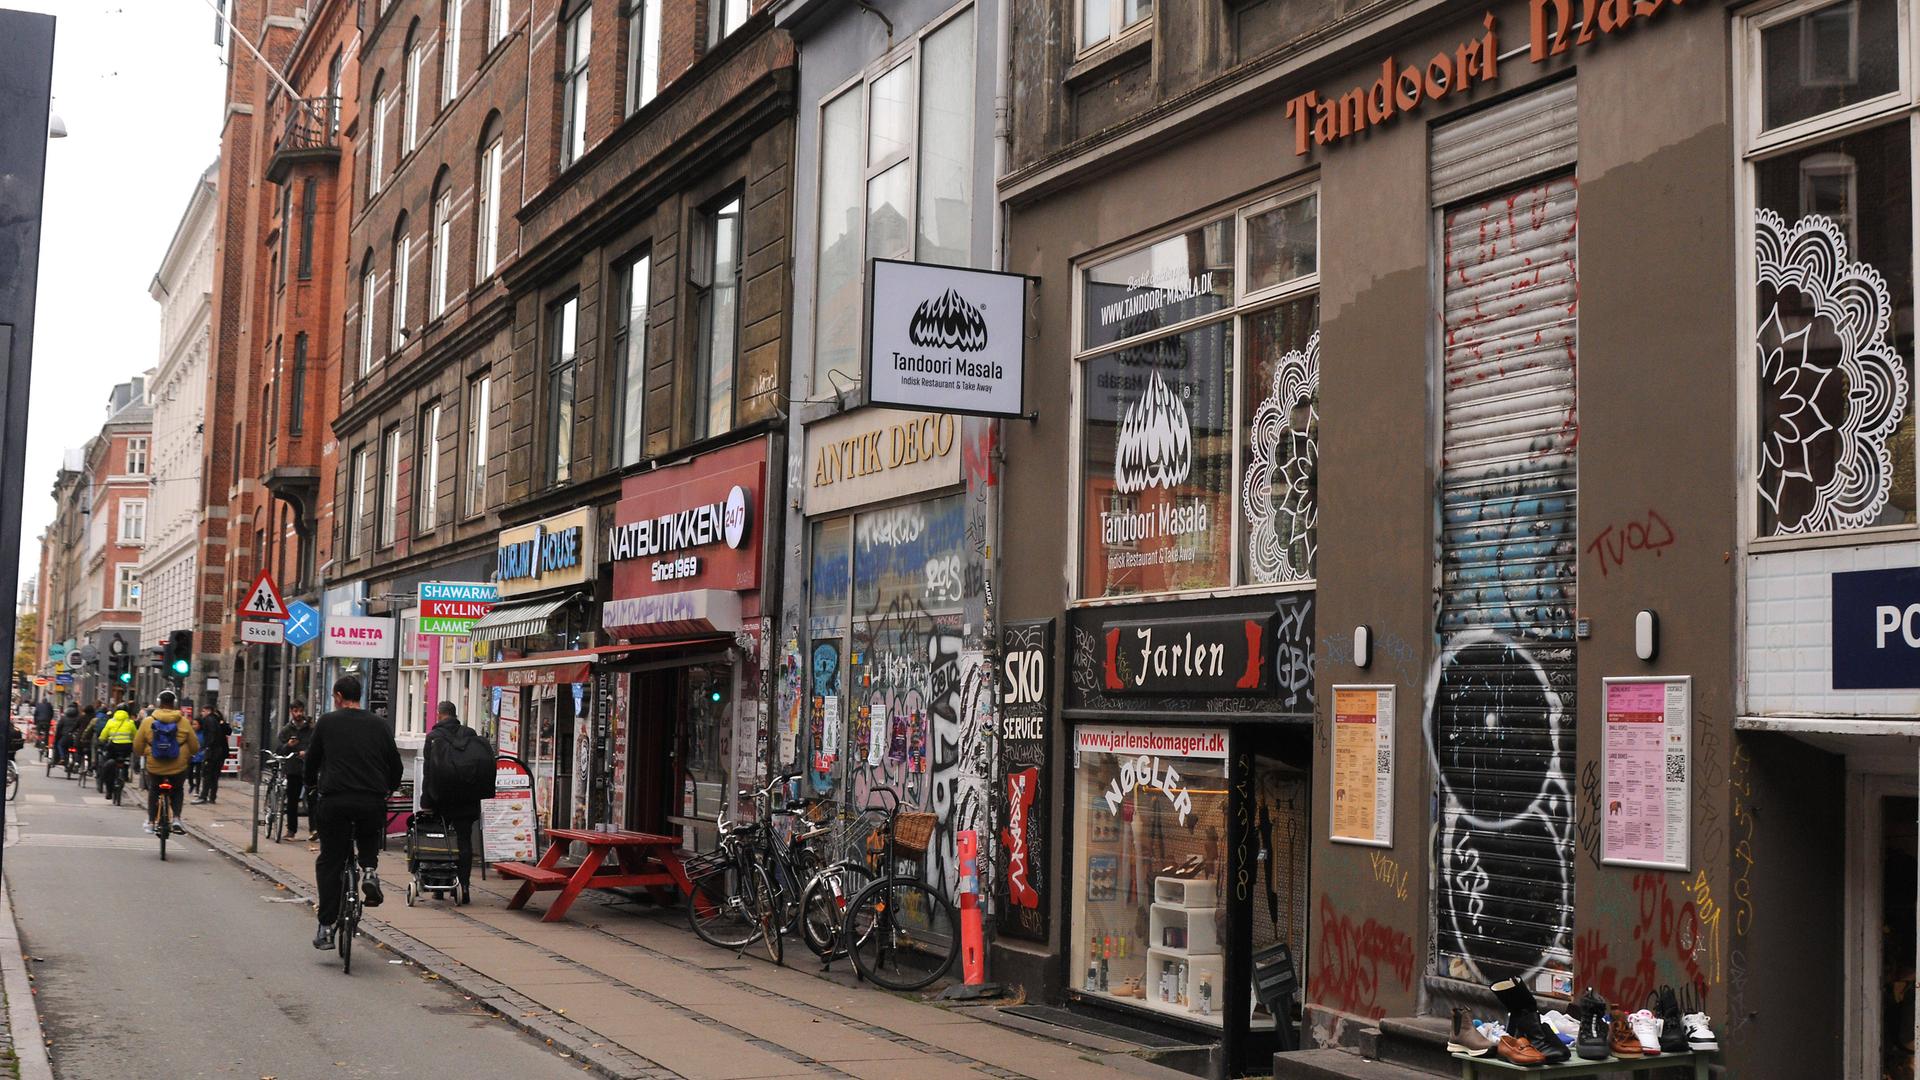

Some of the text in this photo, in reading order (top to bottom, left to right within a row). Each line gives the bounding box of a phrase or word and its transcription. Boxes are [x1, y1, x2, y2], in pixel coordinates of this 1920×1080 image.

[1286, 0, 1688, 156] Tandoori Ma
[1101, 271, 1213, 326] WWW.TANDOORI-MASALA.DK
[892, 352, 1003, 379] Tandoori Masala
[901, 376, 993, 394] Indisk Restaurant & Take Away
[812, 413, 954, 487] ANTIK DECO
[725, 506, 744, 528] 24/7
[1100, 497, 1207, 544] Tandoori Masala
[608, 501, 724, 562] NATBUTIKKEN
[541, 527, 578, 572] HOUSE
[1126, 549, 1158, 568] Restaurant
[1159, 548, 1165, 564] &
[1165, 546, 1179, 563] Take
[1180, 545, 1196, 564] Away
[651, 555, 697, 582] Since 1969
[424, 585, 500, 599] SHAWARMA
[433, 603, 490, 617] KYLLING
[249, 627, 276, 637] Skole
[330, 626, 383, 639] LA NETA
[424, 619, 474, 633] LAMME
[1135, 628, 1225, 686] Jarlen
[1004, 649, 1044, 704] SKO
[1080, 730, 1225, 756] www.jarlenskomageri.dk
[1104, 755, 1192, 827] NØGLER
